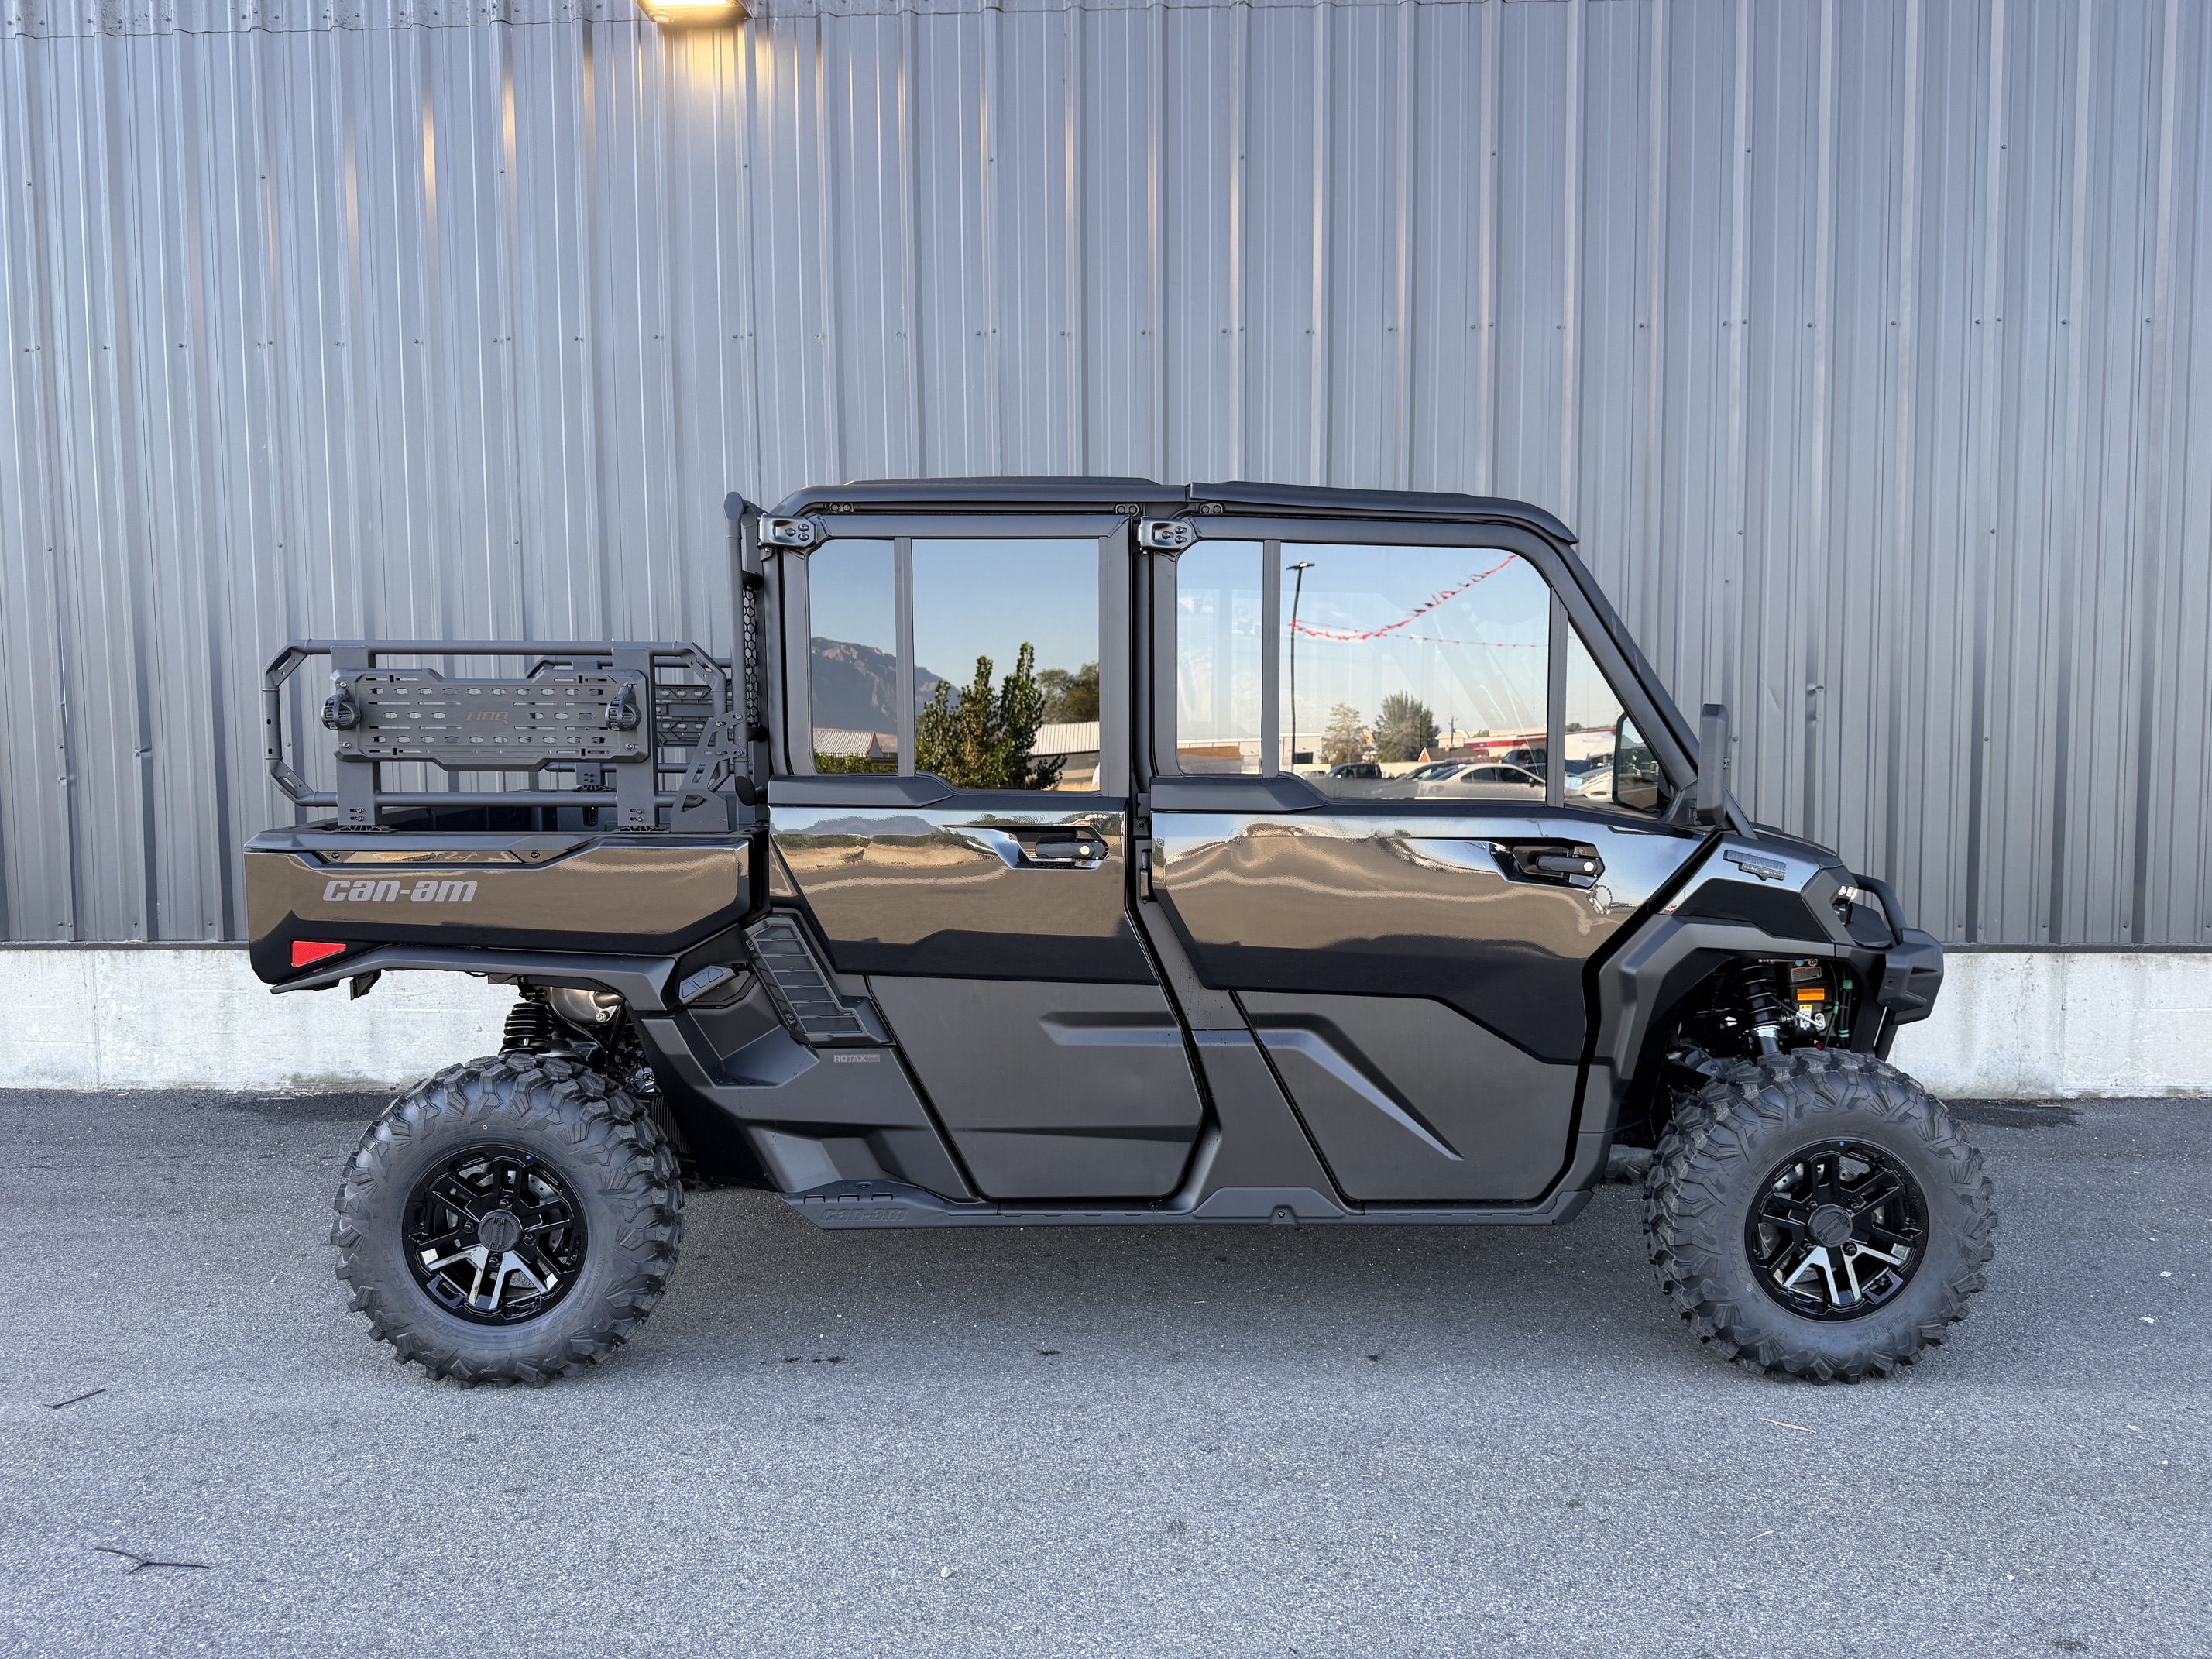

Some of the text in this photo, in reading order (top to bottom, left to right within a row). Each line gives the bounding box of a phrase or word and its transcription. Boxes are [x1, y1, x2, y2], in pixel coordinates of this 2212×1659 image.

[1729, 852, 1786, 871] DEFENDER
[322, 880, 478, 902] can-am
[820, 1208, 907, 1222] can-am
